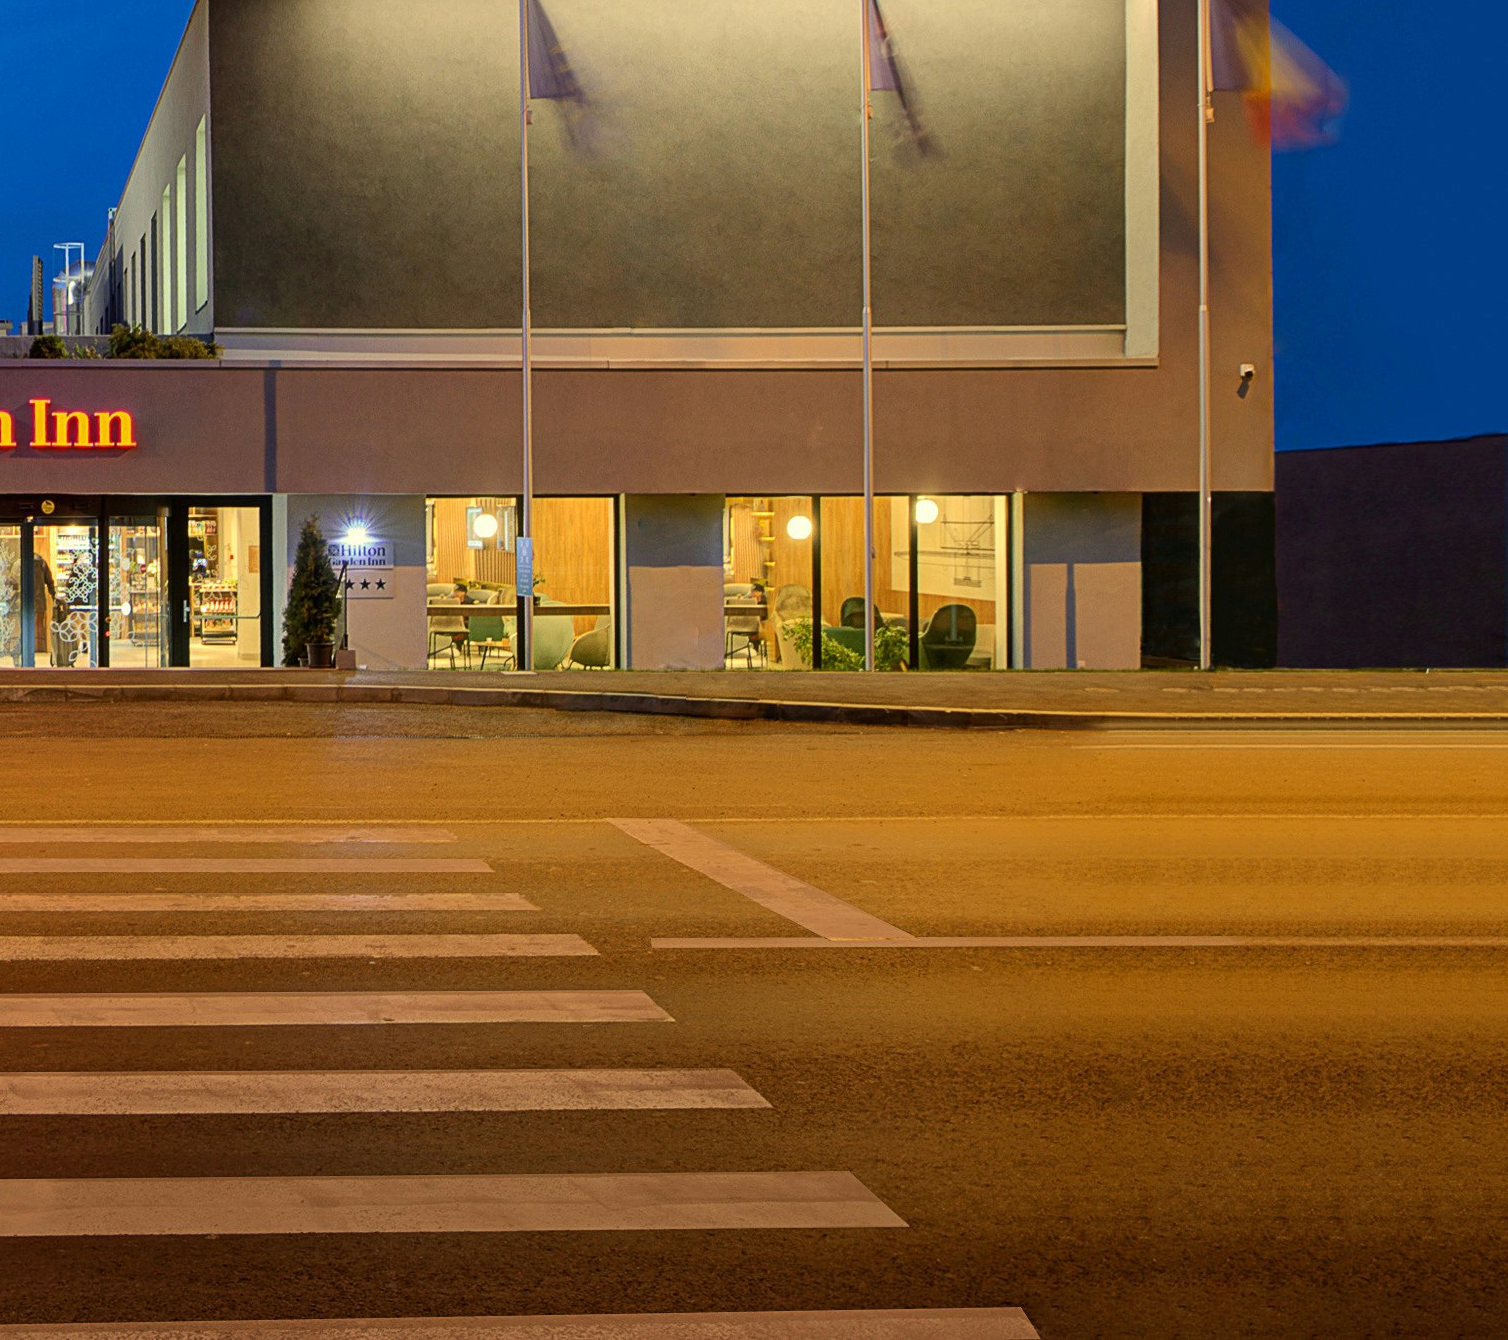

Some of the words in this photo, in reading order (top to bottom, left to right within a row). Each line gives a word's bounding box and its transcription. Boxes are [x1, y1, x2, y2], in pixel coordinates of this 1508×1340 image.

[29, 398, 138, 449] Inn
[341, 544, 386, 556] Hilton
[367, 557, 386, 566] Inn
